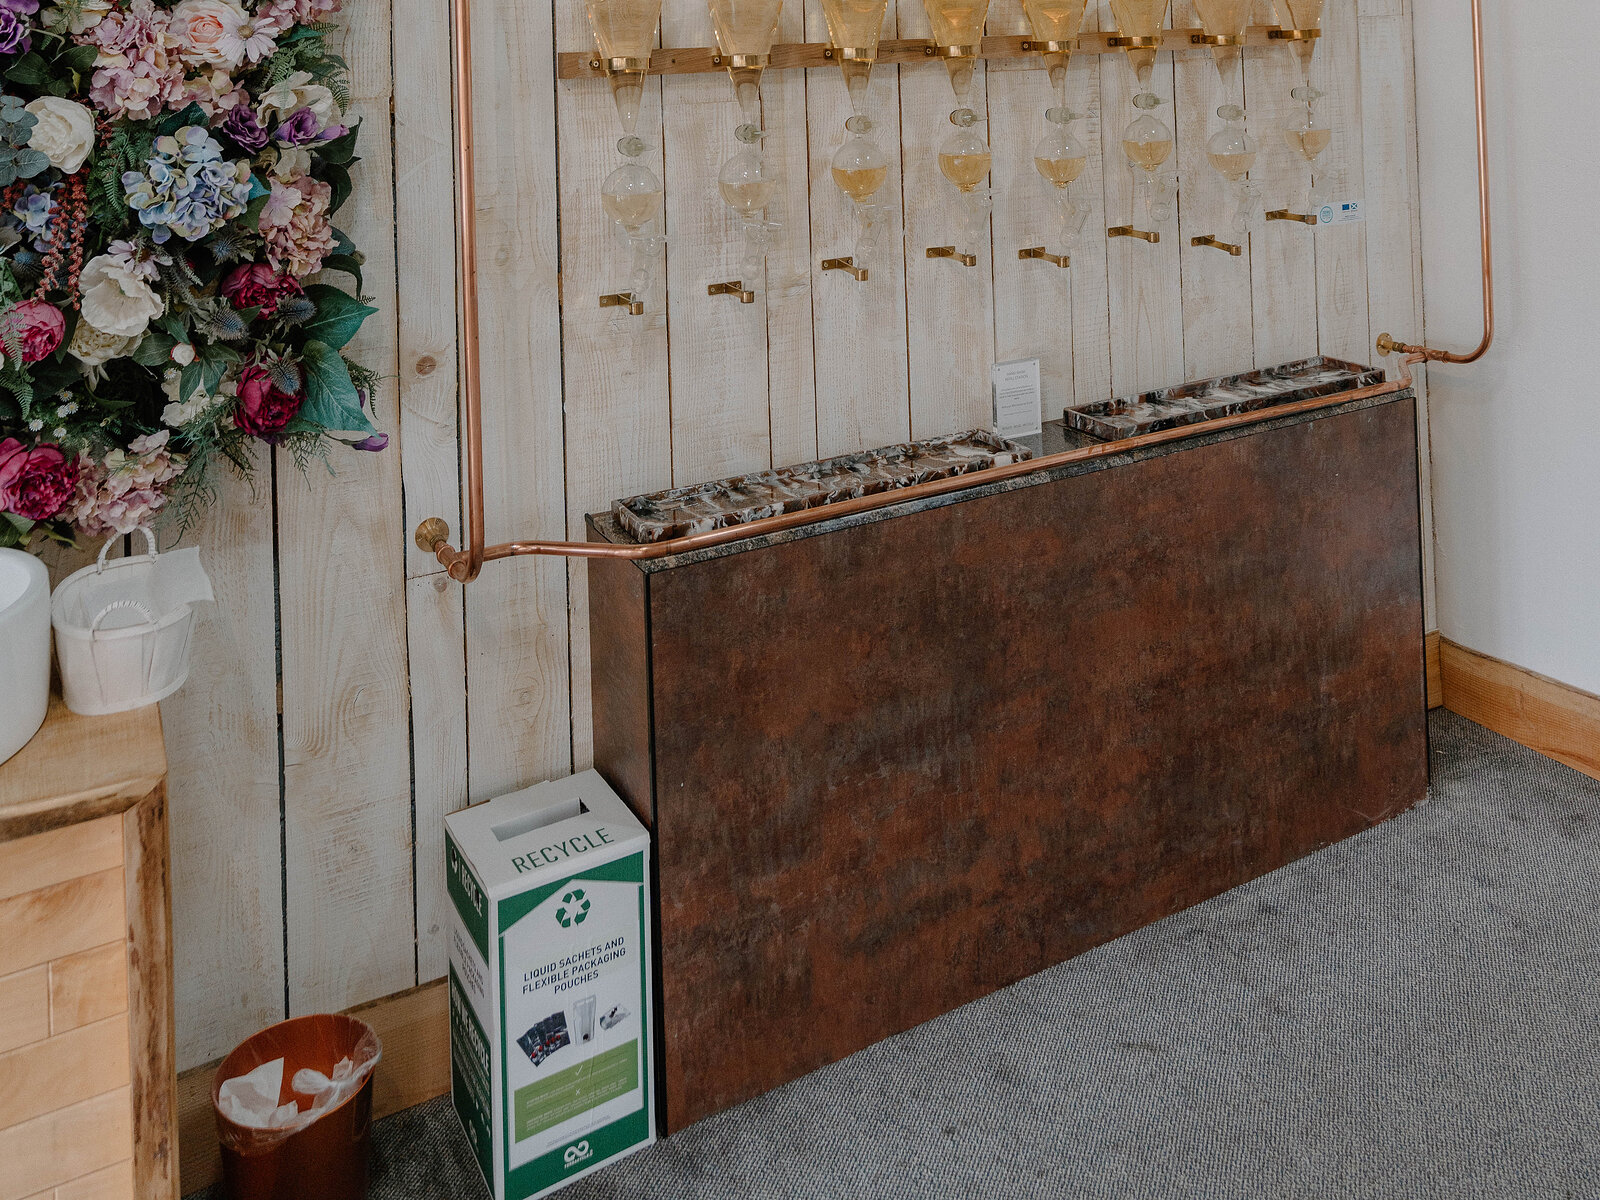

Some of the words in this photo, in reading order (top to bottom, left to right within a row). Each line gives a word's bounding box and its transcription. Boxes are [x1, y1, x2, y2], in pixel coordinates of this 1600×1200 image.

[511, 827, 615, 874] RECYCLE
[522, 969, 570, 995] FLEXIBLE
[571, 947, 626, 976] PACKAGING
[524, 962, 557, 982] LIQUID
[559, 944, 603, 968] SACHETS
[604, 936, 625, 951] AND
[554, 969, 600, 994] POUCHES
